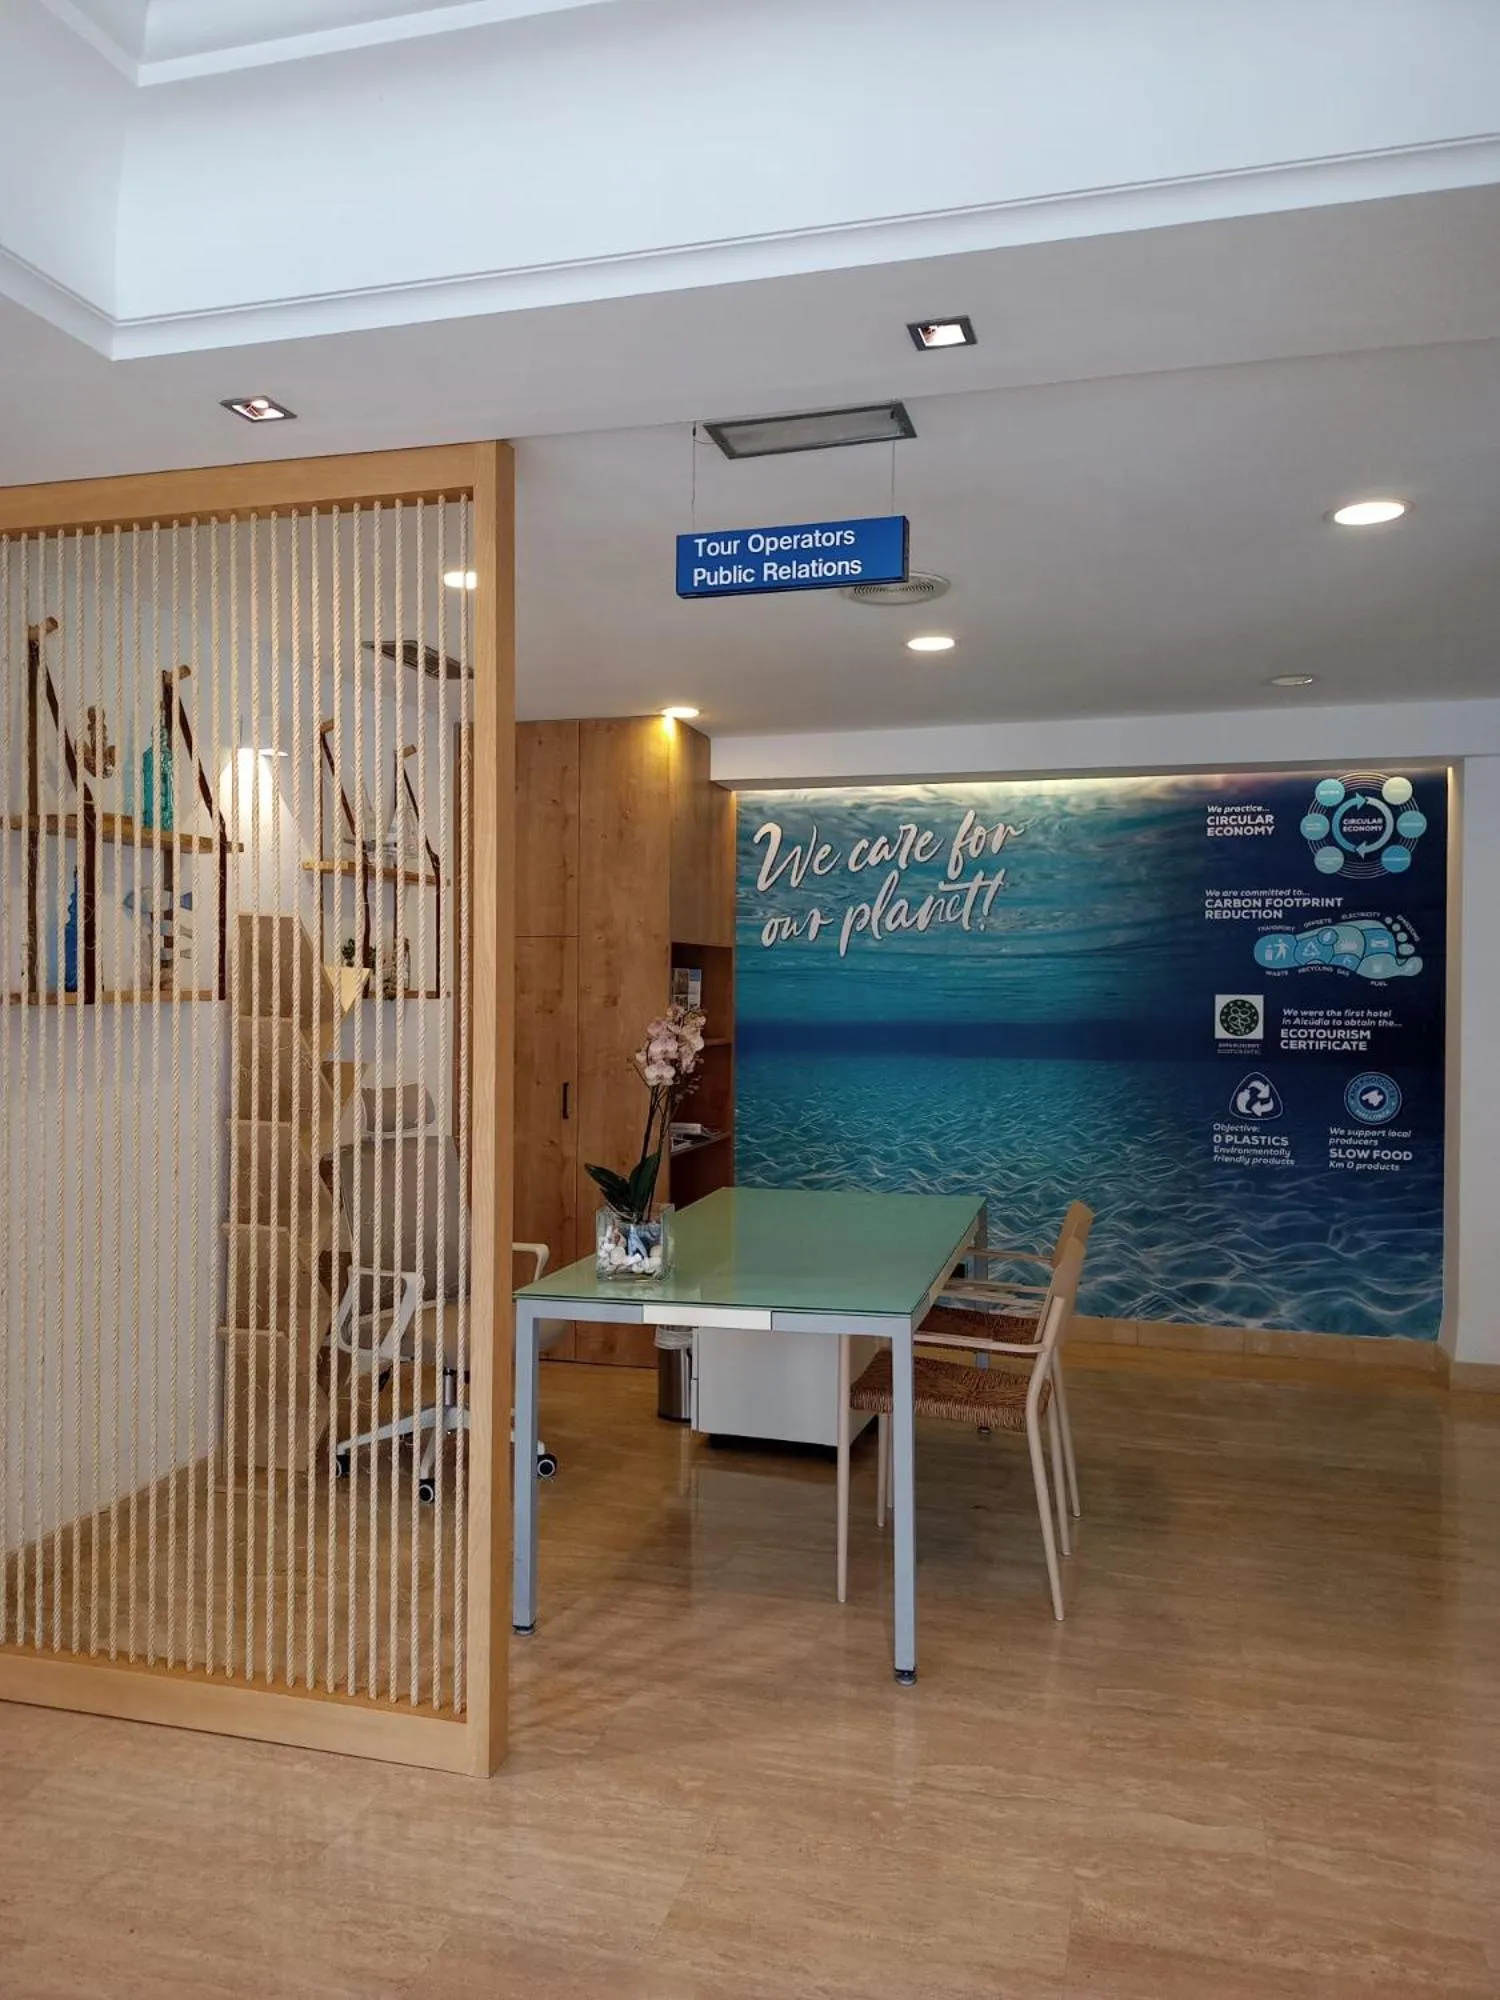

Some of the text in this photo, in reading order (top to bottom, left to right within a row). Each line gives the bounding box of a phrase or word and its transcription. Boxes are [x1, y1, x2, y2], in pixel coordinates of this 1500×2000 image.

[694, 529, 855, 557] Tour Operators
[692, 558, 862, 587] Public Relations
[1207, 805, 1221, 813] We
[1206, 814, 1275, 826] CIRCULAR
[1343, 817, 1383, 825] CIRCULAR
[1206, 825, 1276, 837] ECONOMY
[1343, 825, 1383, 833] ECONOMY
[753, 810, 1028, 892] We care for
[1205, 889, 1220, 897] We
[1240, 888, 1291, 897] committed
[1205, 897, 1344, 909] CARBON FOOTPRINT
[761, 868, 1005, 958] our planet!
[1204, 909, 1283, 920] REDUCTION
[1283, 1008, 1298, 1017] We
[1326, 1009, 1342, 1017] the
[1344, 1008, 1364, 1018] first
[1366, 1009, 1392, 1018] hotel
[1282, 1017, 1291, 1025] in
[1332, 1018, 1342, 1026] to
[1344, 1018, 1376, 1027] obtain
[1280, 1028, 1371, 1039] ECOTOURISM
[1280, 1039, 1368, 1051] CERTIFICATE
[1329, 1127, 1412, 1138] We support local
[1225, 1135, 1289, 1146] PLASTICS
[1329, 1137, 1378, 1146] producers
[1213, 1145, 1291, 1158] Environmentally
[1329, 1148, 1413, 1161] SLOW FOOD
[1213, 1154, 1295, 1166] friendly products
[1329, 1160, 1345, 1169] Km
[1355, 1162, 1400, 1172] products
